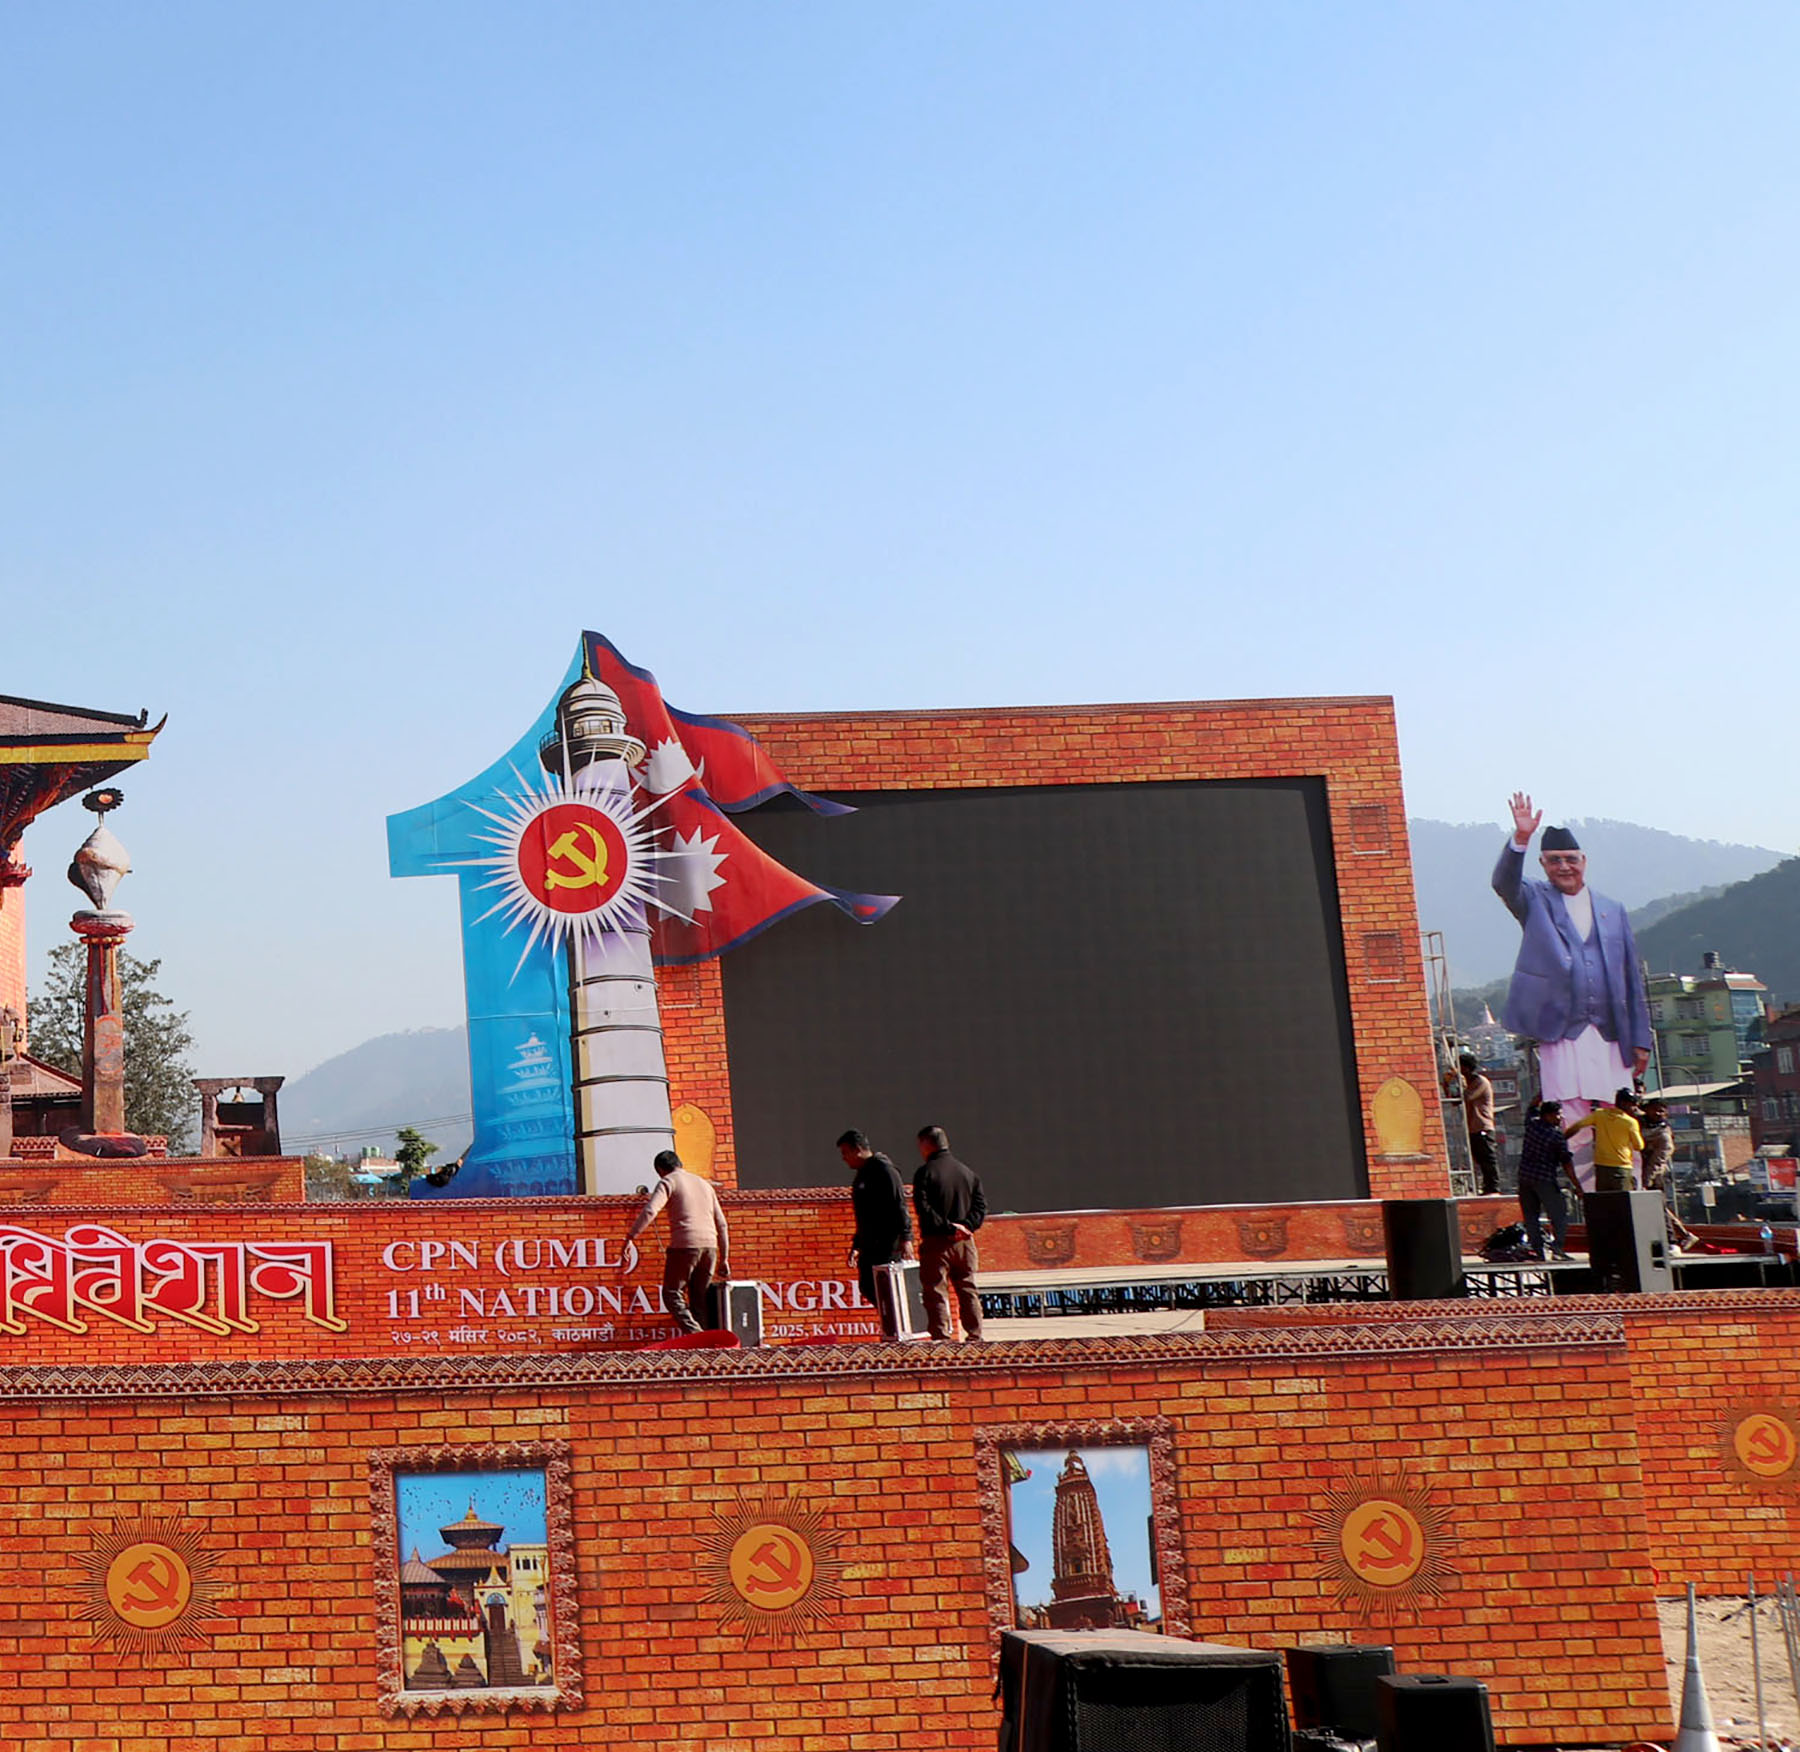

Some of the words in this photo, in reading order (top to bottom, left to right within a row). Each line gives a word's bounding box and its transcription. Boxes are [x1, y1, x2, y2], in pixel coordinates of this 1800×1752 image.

[382, 1239, 479, 1272] CPN
[494, 1237, 640, 1277] (UML)
[385, 1282, 447, 1320] 11th
[447, 1325, 489, 1343] मंसिर
[628, 1327, 667, 1342] 13-15
